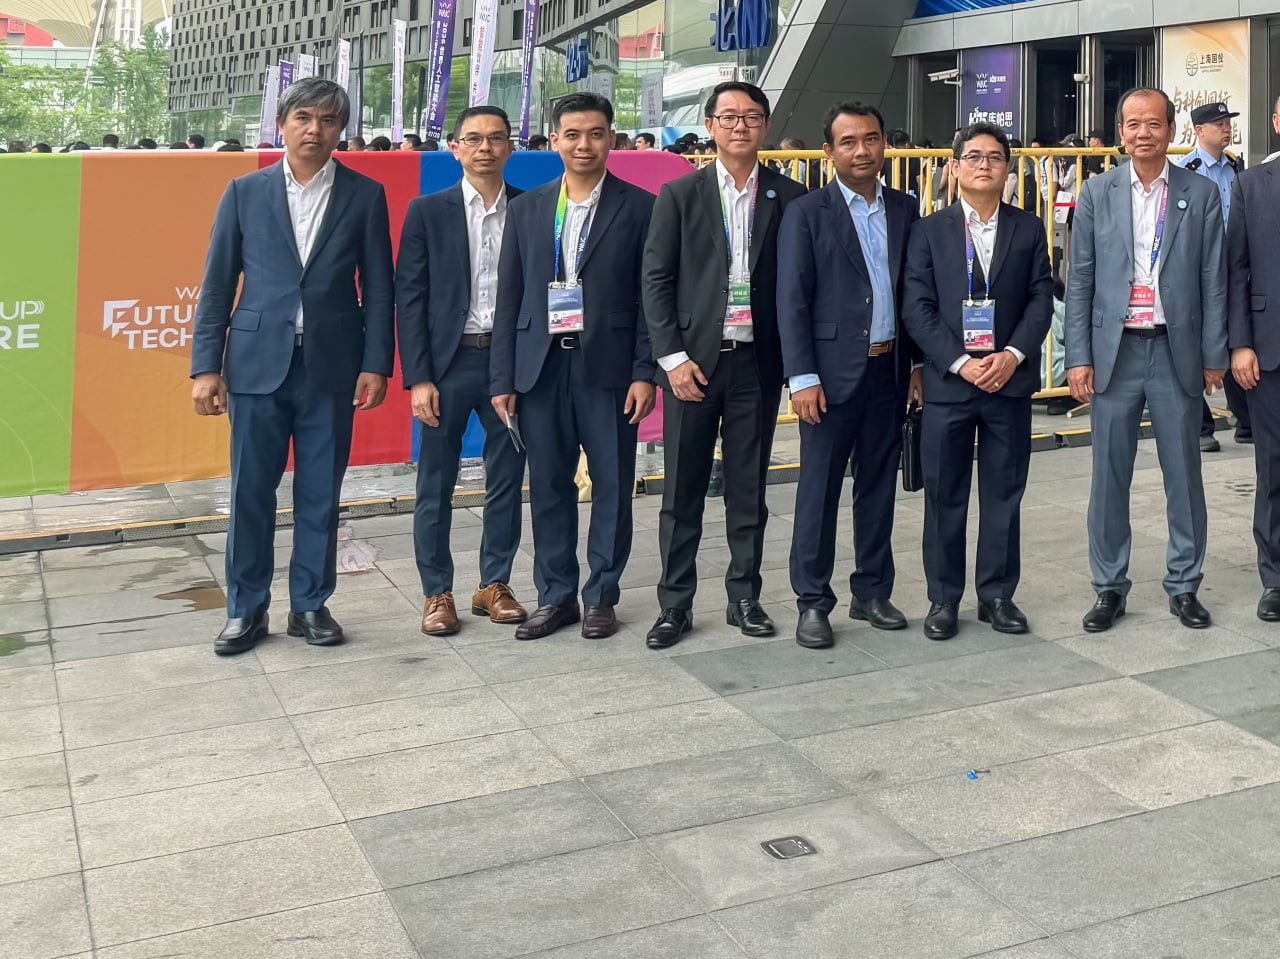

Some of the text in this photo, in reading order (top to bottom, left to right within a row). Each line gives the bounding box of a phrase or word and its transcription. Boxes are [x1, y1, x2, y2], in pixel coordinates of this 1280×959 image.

[1199, 52, 1224, 65] 上海国投
[103, 299, 197, 339] FUTU
